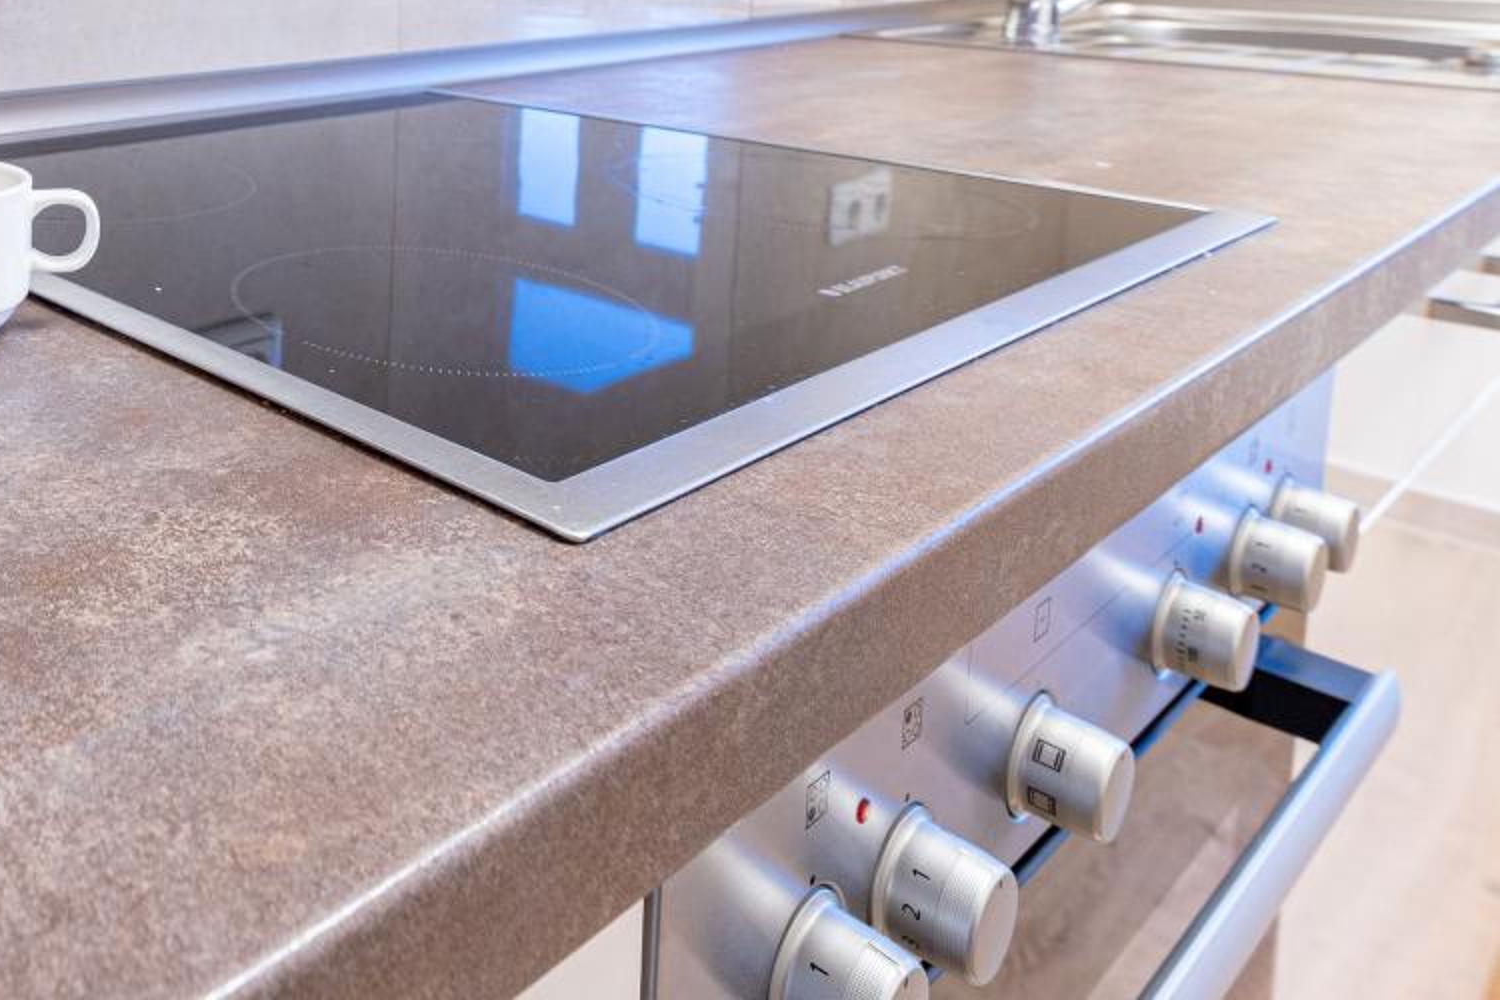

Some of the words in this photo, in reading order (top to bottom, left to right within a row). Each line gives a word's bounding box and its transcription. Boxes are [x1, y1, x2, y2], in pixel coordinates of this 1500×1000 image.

[912, 868, 931, 881] 1
[901, 902, 921, 921] 2
[809, 961, 830, 977] 1
